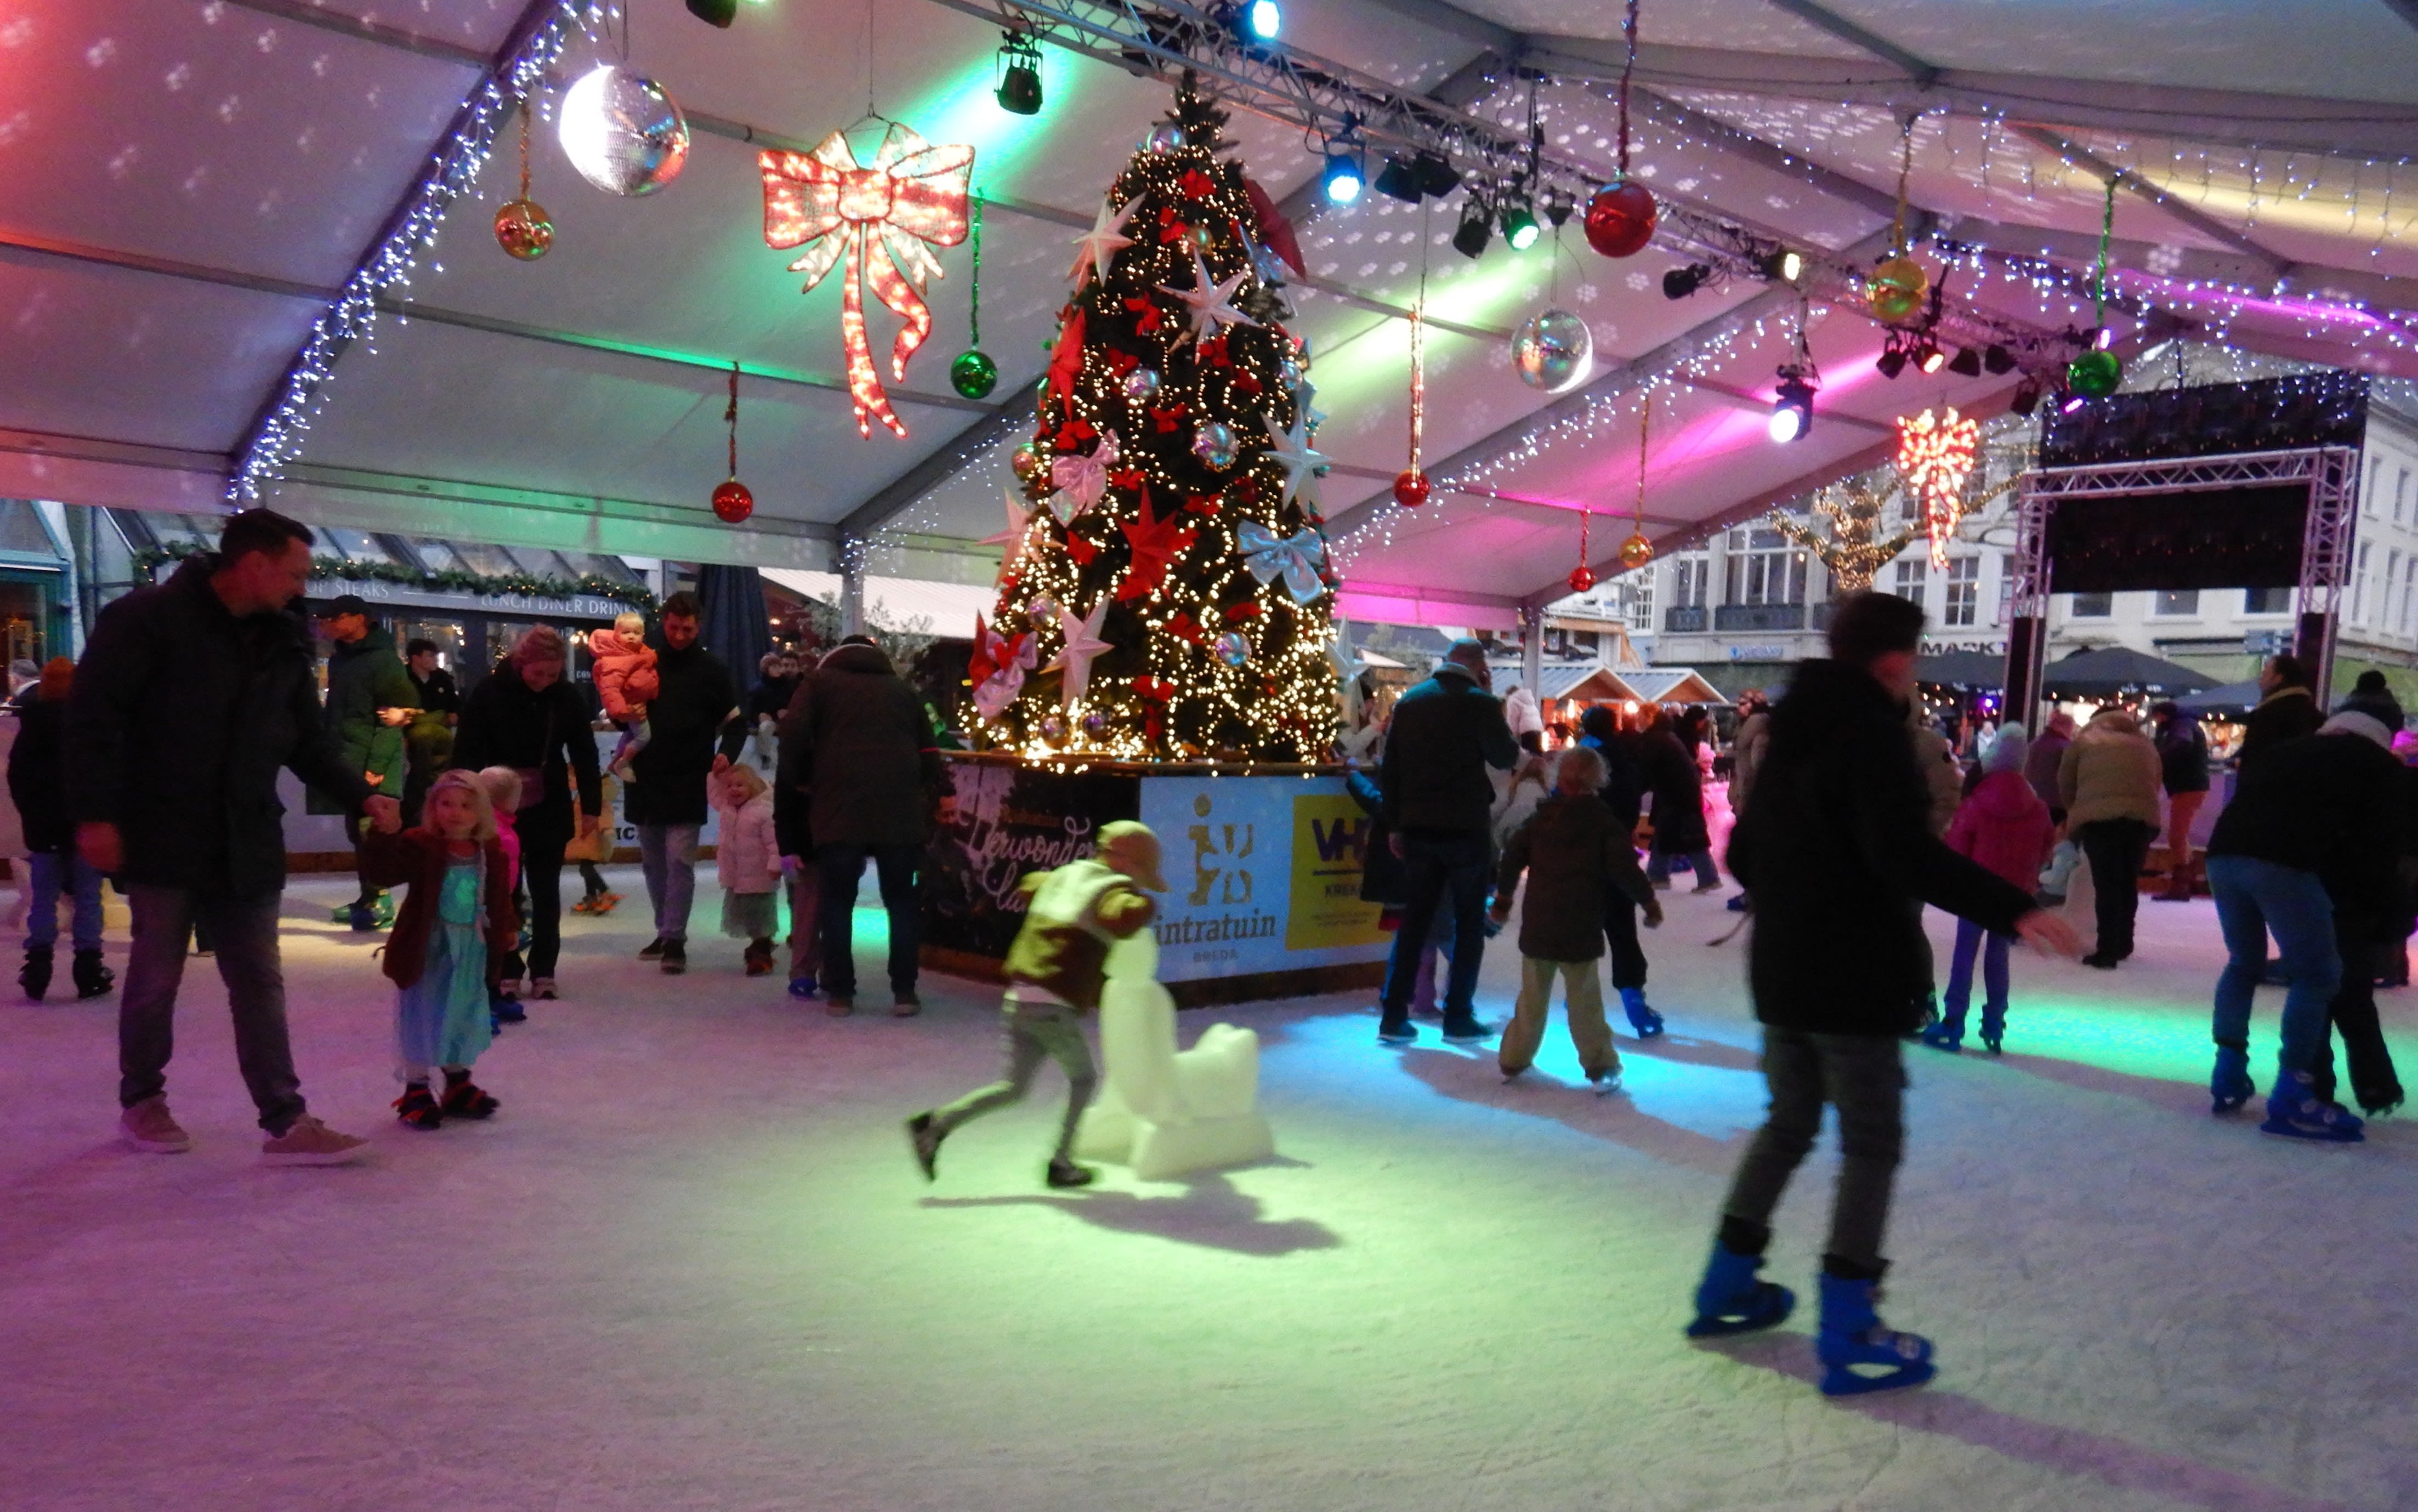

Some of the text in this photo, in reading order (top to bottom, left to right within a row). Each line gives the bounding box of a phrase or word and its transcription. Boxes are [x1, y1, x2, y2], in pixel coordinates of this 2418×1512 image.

[333, 581, 389, 598] STEAKS
[481, 594, 531, 610] LUNCH
[538, 598, 582, 613] DINER
[1154, 907, 1276, 946] intratuin
